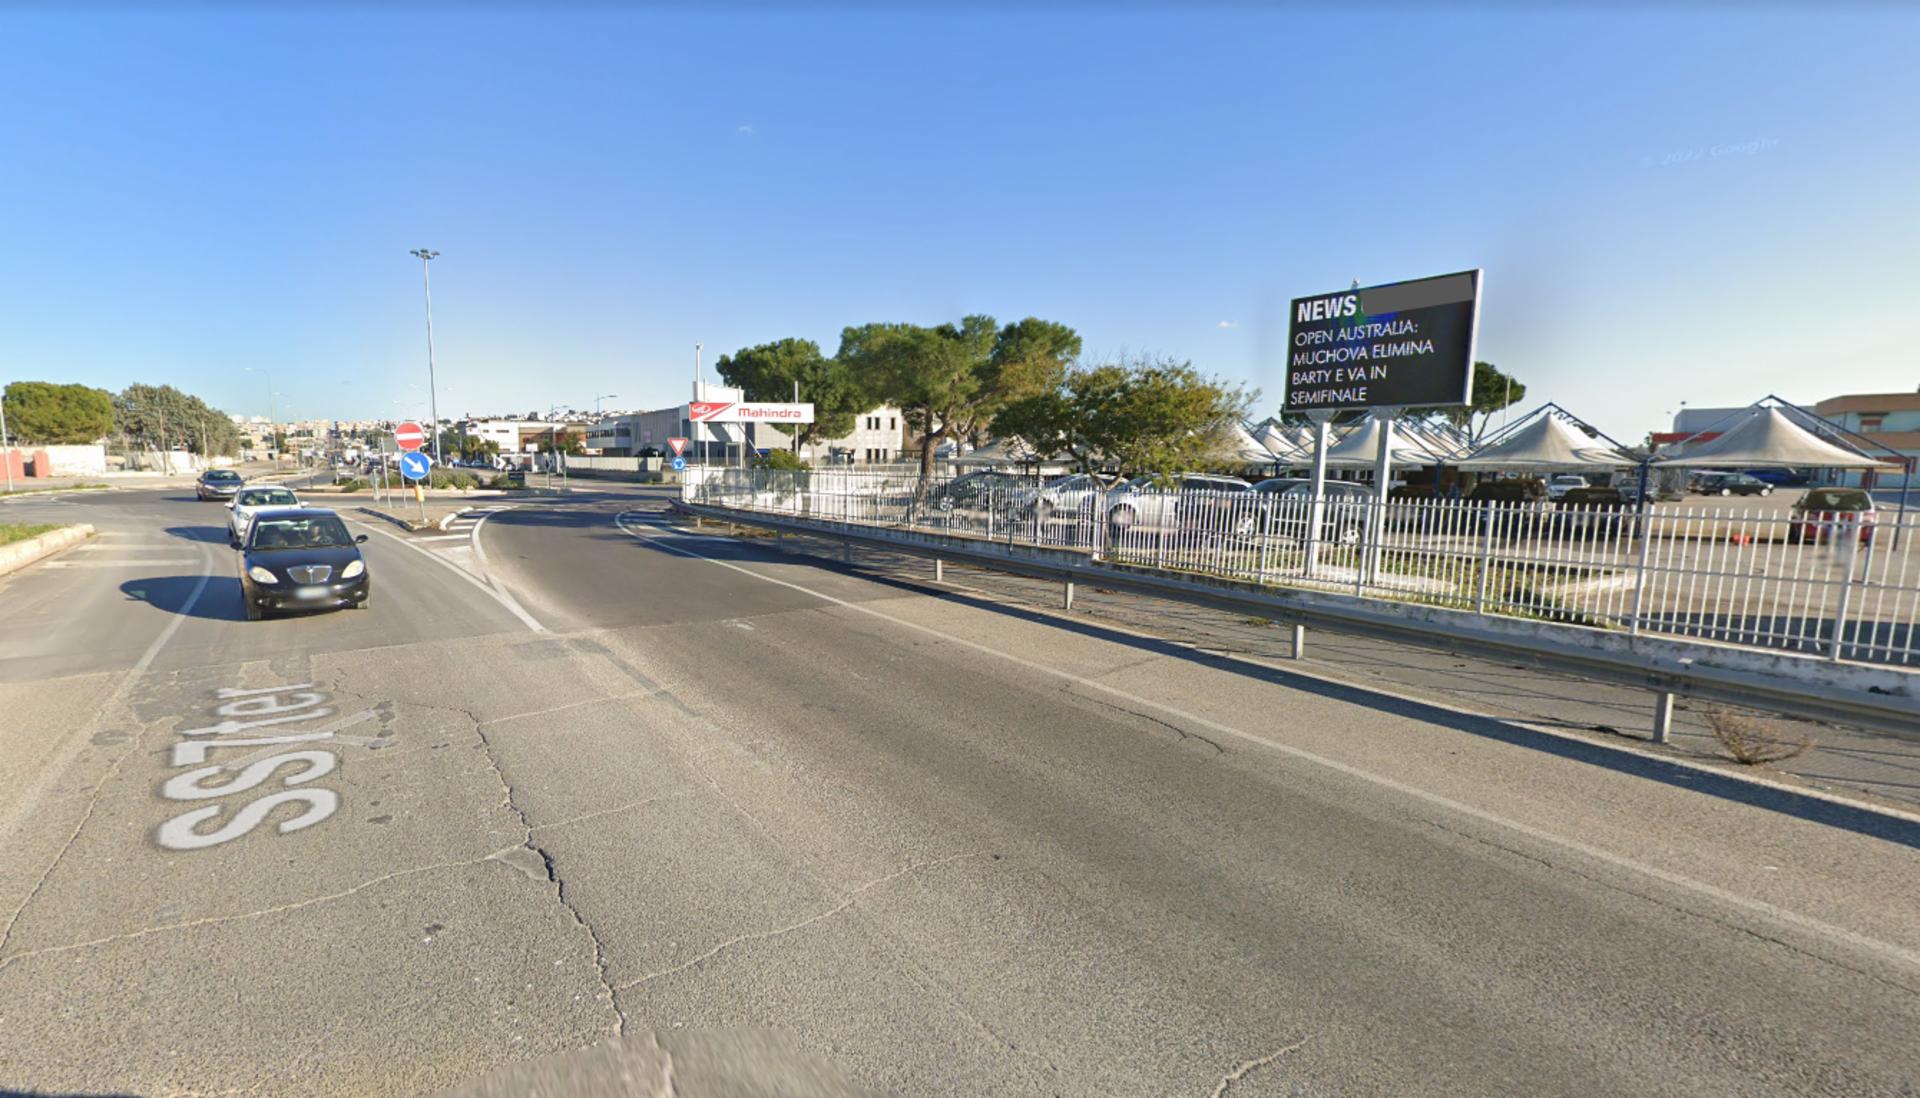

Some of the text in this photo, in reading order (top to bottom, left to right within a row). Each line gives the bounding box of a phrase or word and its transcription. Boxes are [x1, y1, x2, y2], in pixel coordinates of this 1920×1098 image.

[1297, 295, 1357, 323] NEWS
[1294, 319, 1419, 347] OPEN AUSTRALIA:
[1292, 339, 1434, 366] MUCHOVA ELIMINA
[1292, 365, 1388, 386] BARTY E VA IN
[1290, 386, 1368, 406] SEMIFINALE
[738, 407, 802, 418] Mahindra
